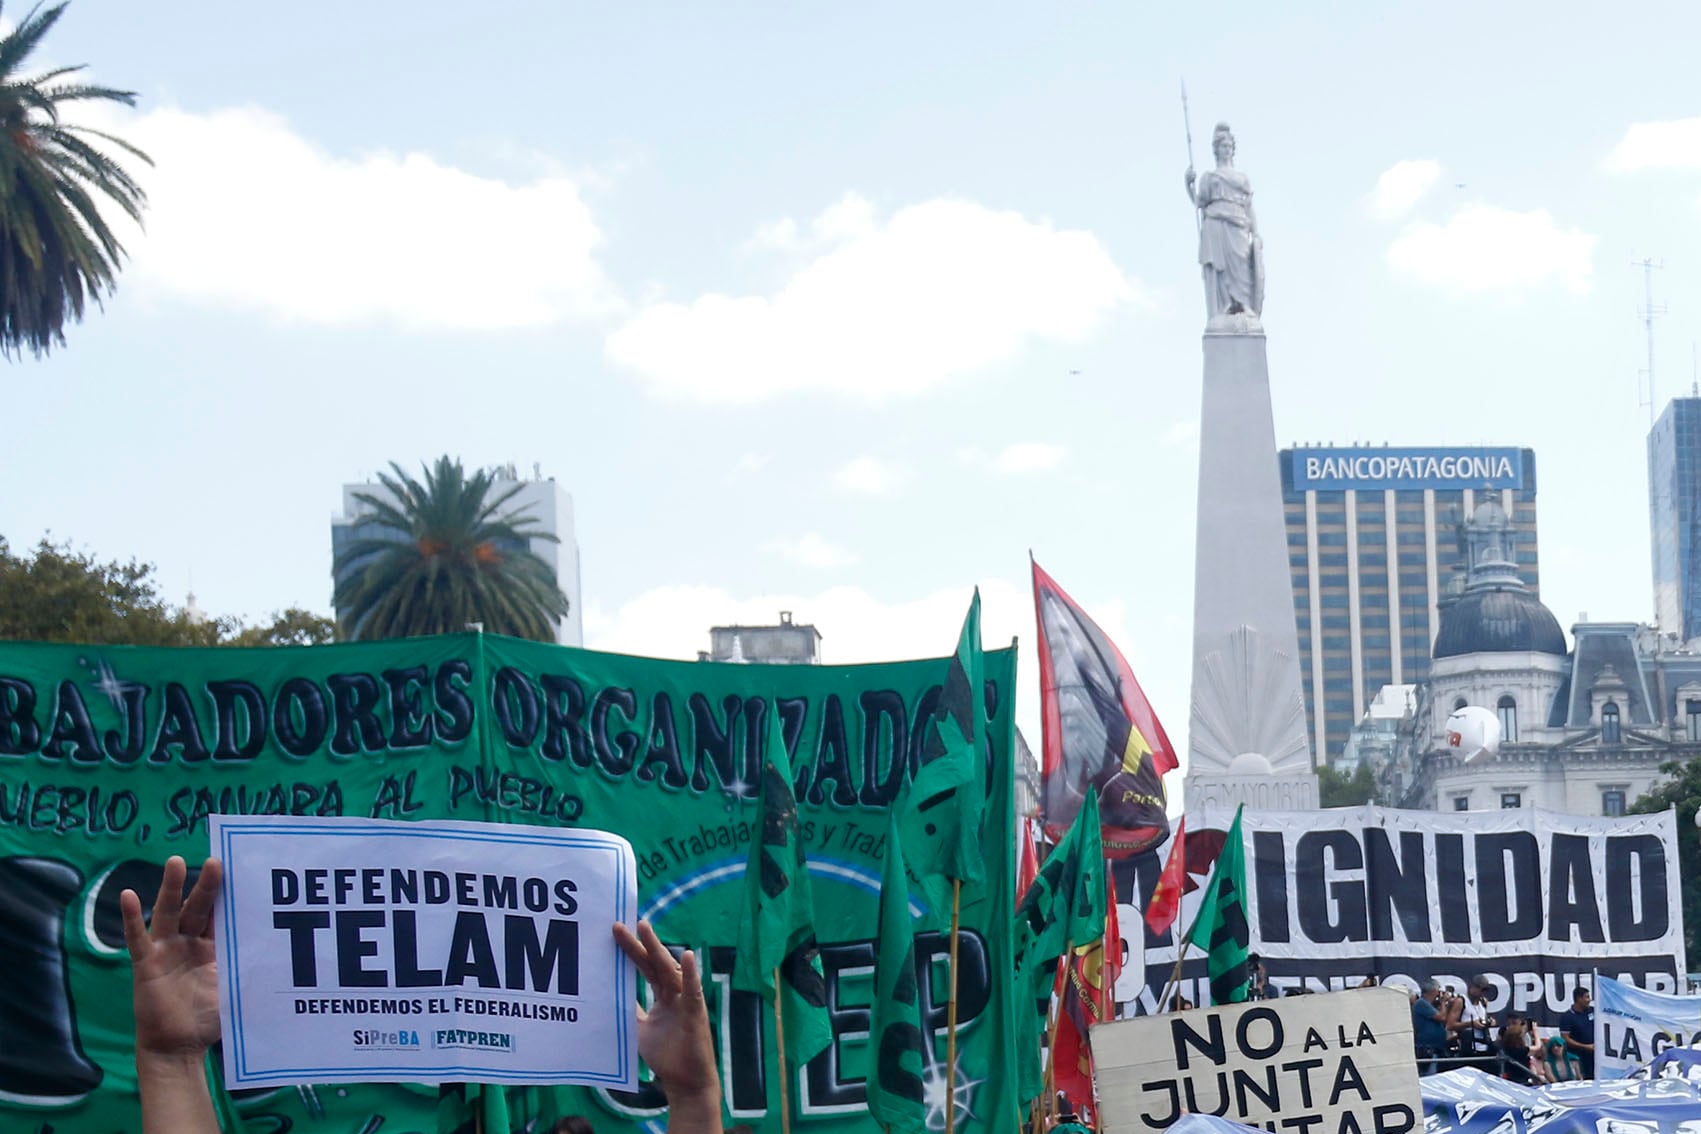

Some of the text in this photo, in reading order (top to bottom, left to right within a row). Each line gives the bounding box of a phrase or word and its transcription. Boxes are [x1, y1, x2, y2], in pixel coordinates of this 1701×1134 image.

[1306, 456, 1515, 481] BANCOPATAGONIA
[271, 868, 579, 915] DEFENDEMOS
[273, 910, 580, 996] TELAM
[295, 998, 579, 1022] DEFENDEMOS EL FEDERALISMO
[353, 1029, 511, 1048] SiPreBA FATPREN
[1171, 1007, 1376, 1070] NO A LA
[1604, 1023, 1643, 1062] LA
[1140, 1055, 1371, 1128] JUNTA
